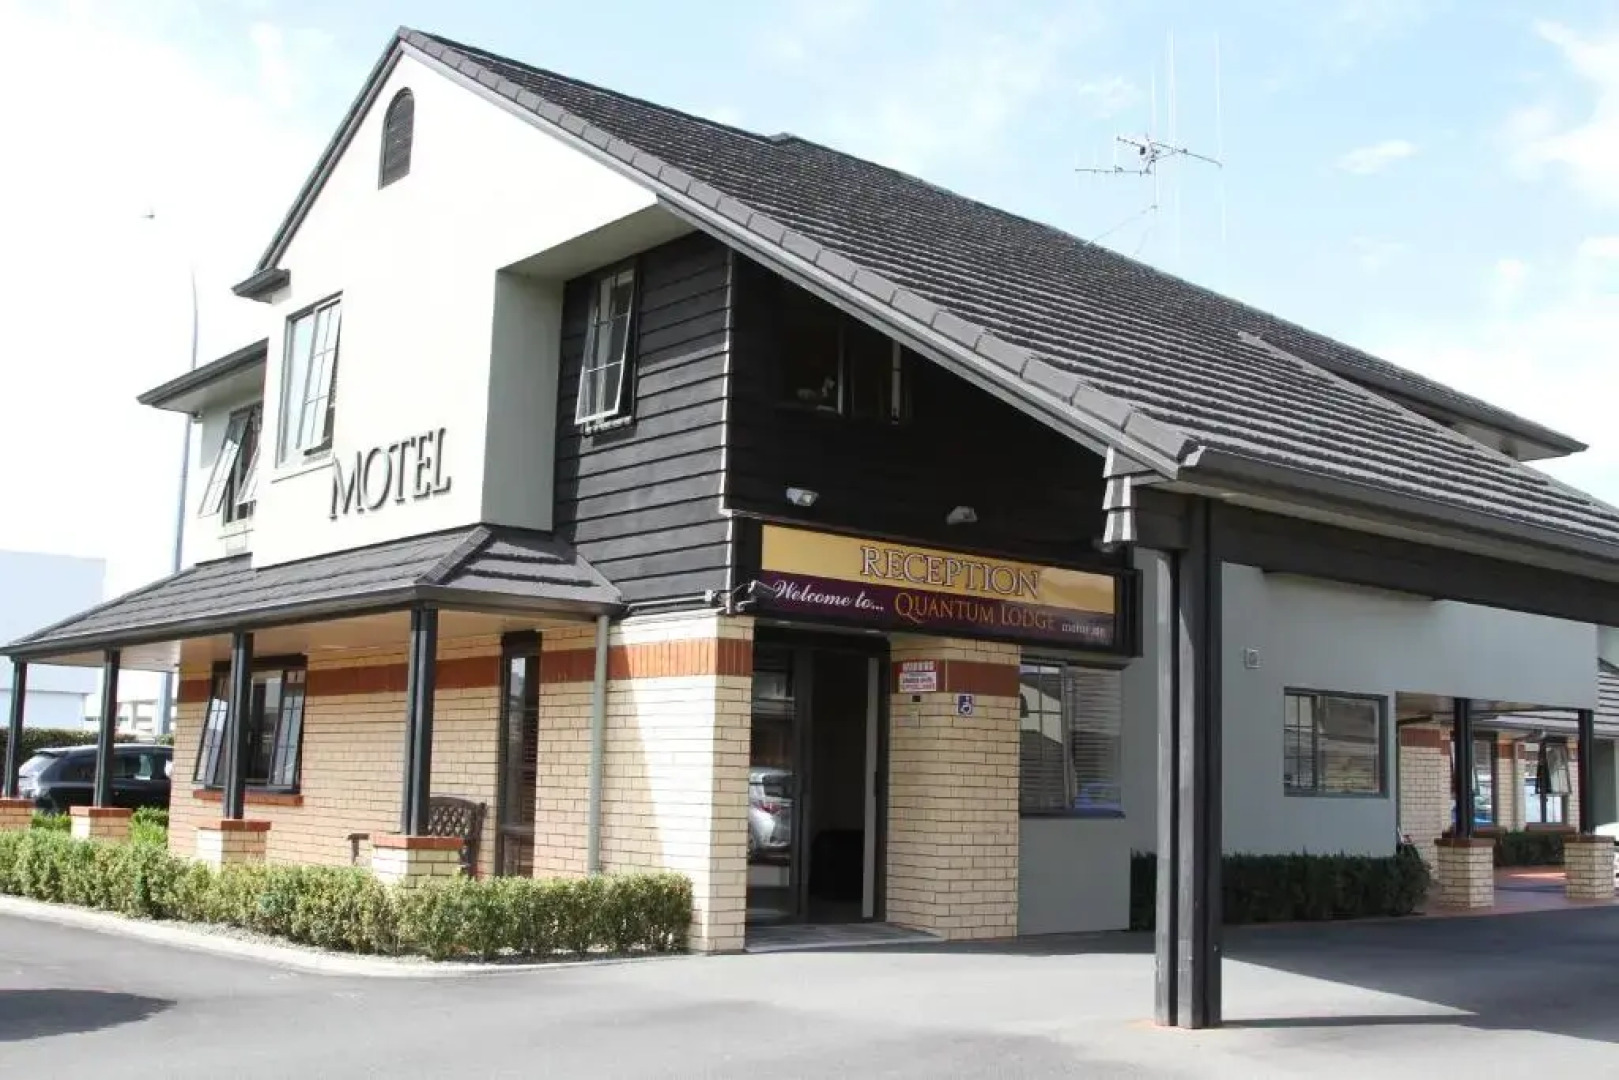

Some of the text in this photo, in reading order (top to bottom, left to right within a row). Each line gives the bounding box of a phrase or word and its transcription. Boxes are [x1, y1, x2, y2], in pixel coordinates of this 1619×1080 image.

[329, 427, 452, 520] MOTEL
[860, 546, 1040, 598] RECEPTION
[773, 580, 1056, 630] Welcome to... QUANTUM LODGE
